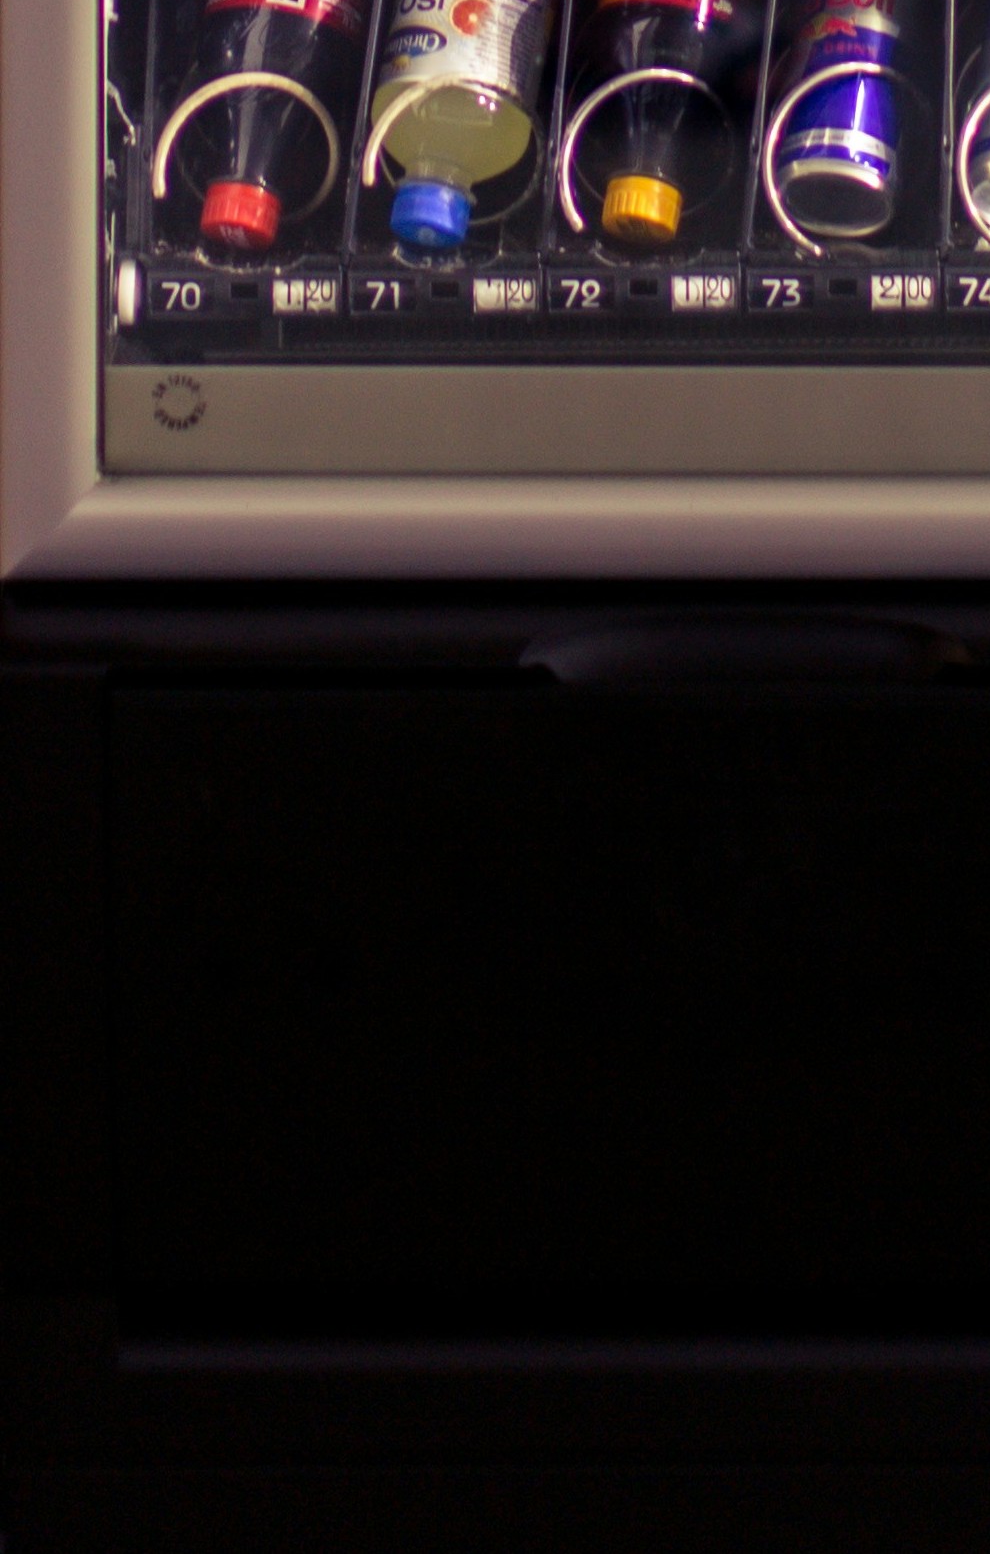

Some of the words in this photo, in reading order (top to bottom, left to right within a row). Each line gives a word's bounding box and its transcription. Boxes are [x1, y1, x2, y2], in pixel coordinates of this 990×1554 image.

[162, 282, 201, 308] 70
[366, 282, 400, 308] 71
[560, 280, 601, 307] 72
[762, 280, 802, 306] 73
